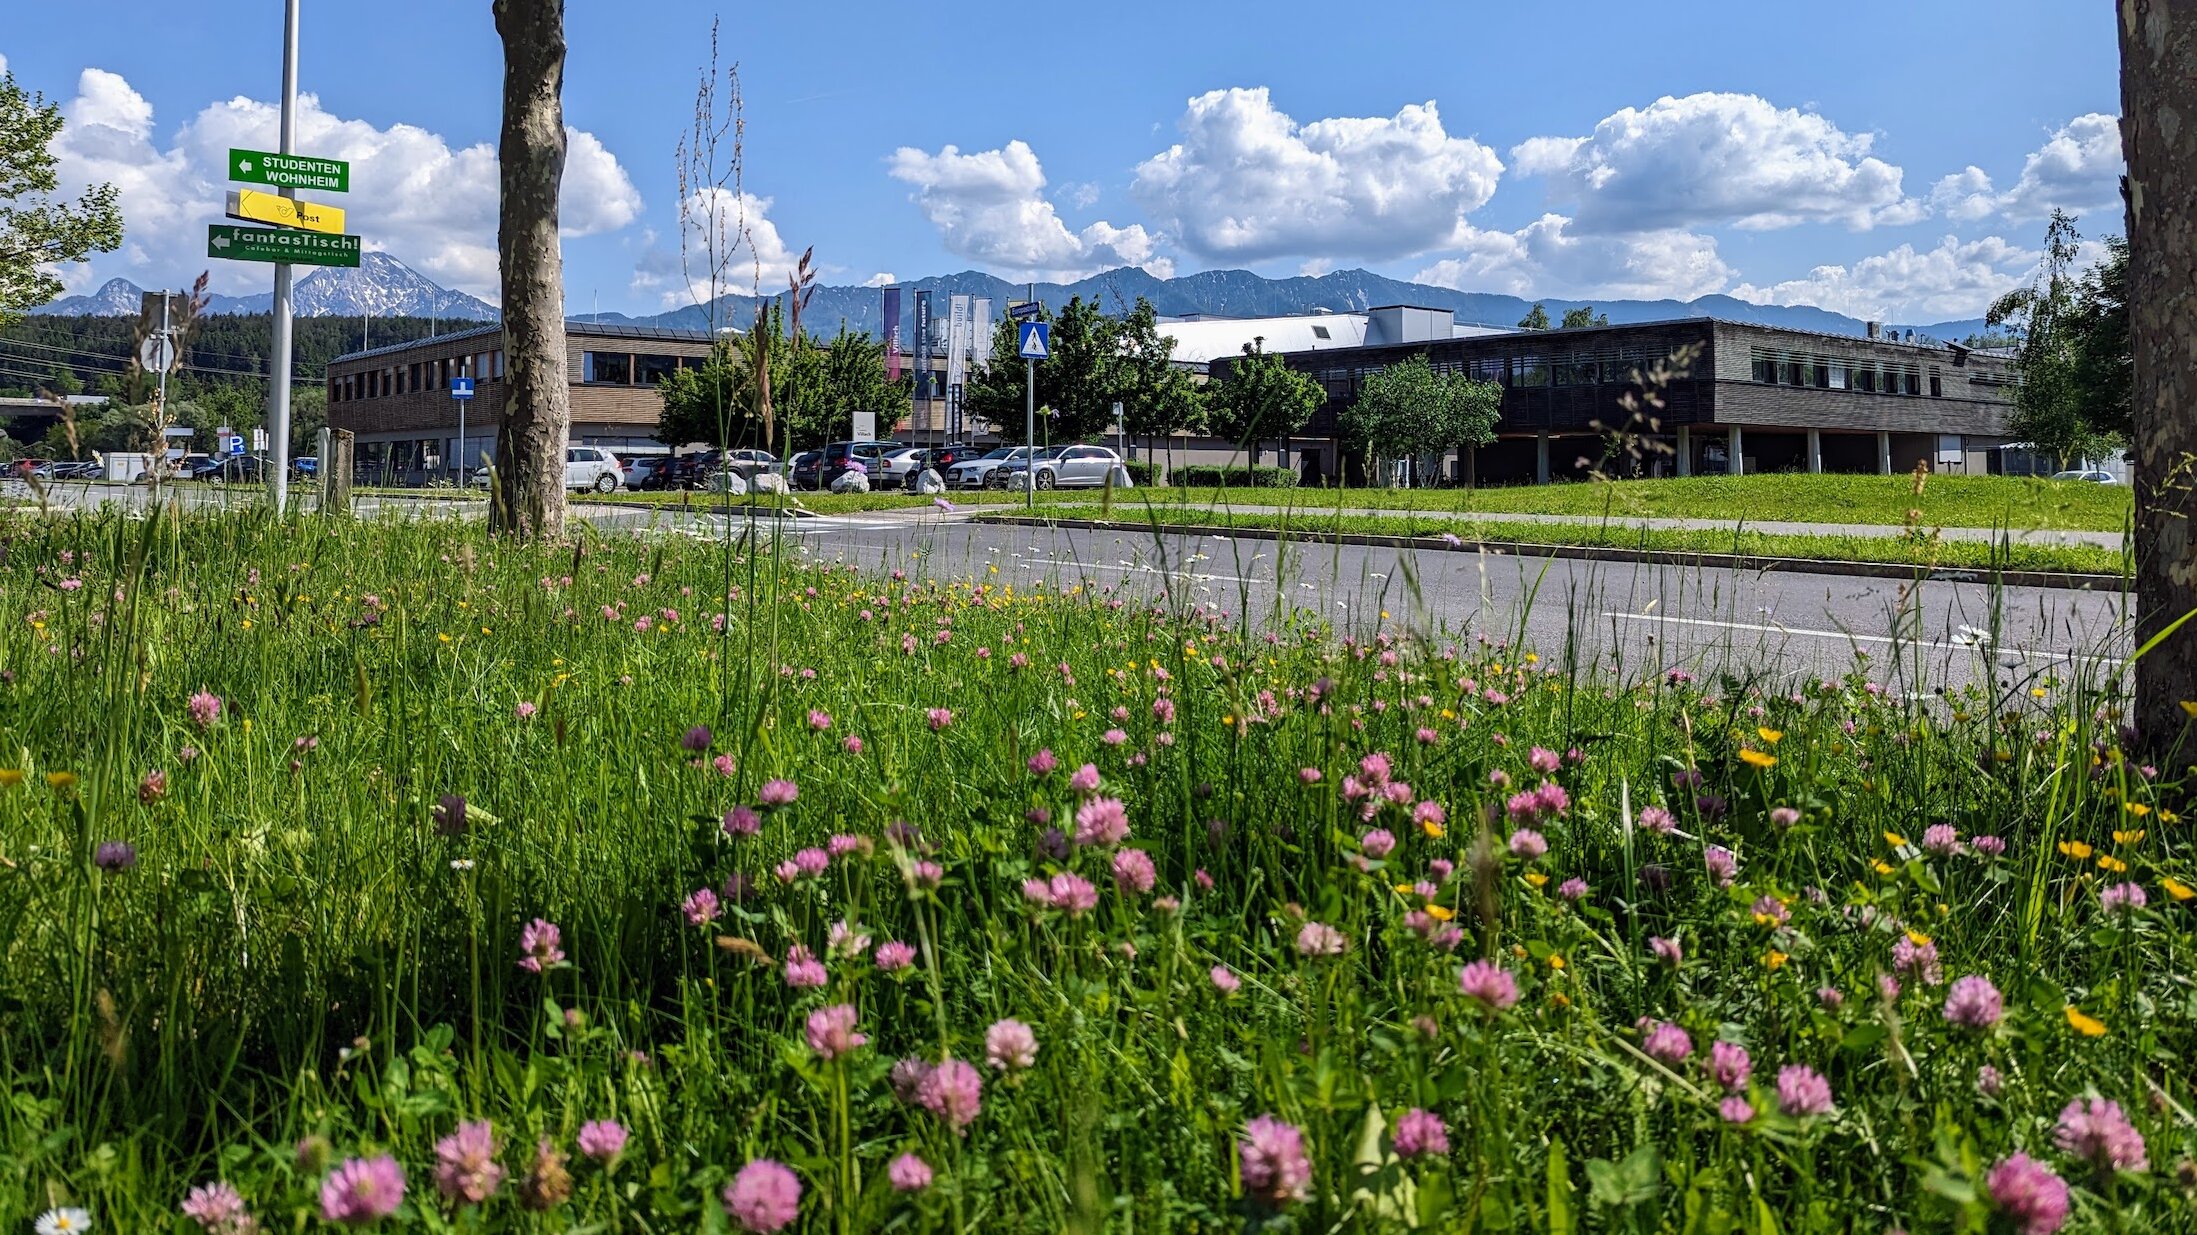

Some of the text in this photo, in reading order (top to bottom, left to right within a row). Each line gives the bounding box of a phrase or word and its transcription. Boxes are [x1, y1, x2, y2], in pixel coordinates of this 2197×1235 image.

[263, 157, 341, 175] STUDENTEN
[265, 170, 339, 188] WOHNHEIM
[296, 211, 321, 223] Post
[232, 229, 359, 250] fantasTisch!
[293, 248, 349, 258] Mittagstisch
[954, 303, 963, 327] build!
[230, 435, 244, 451] P
